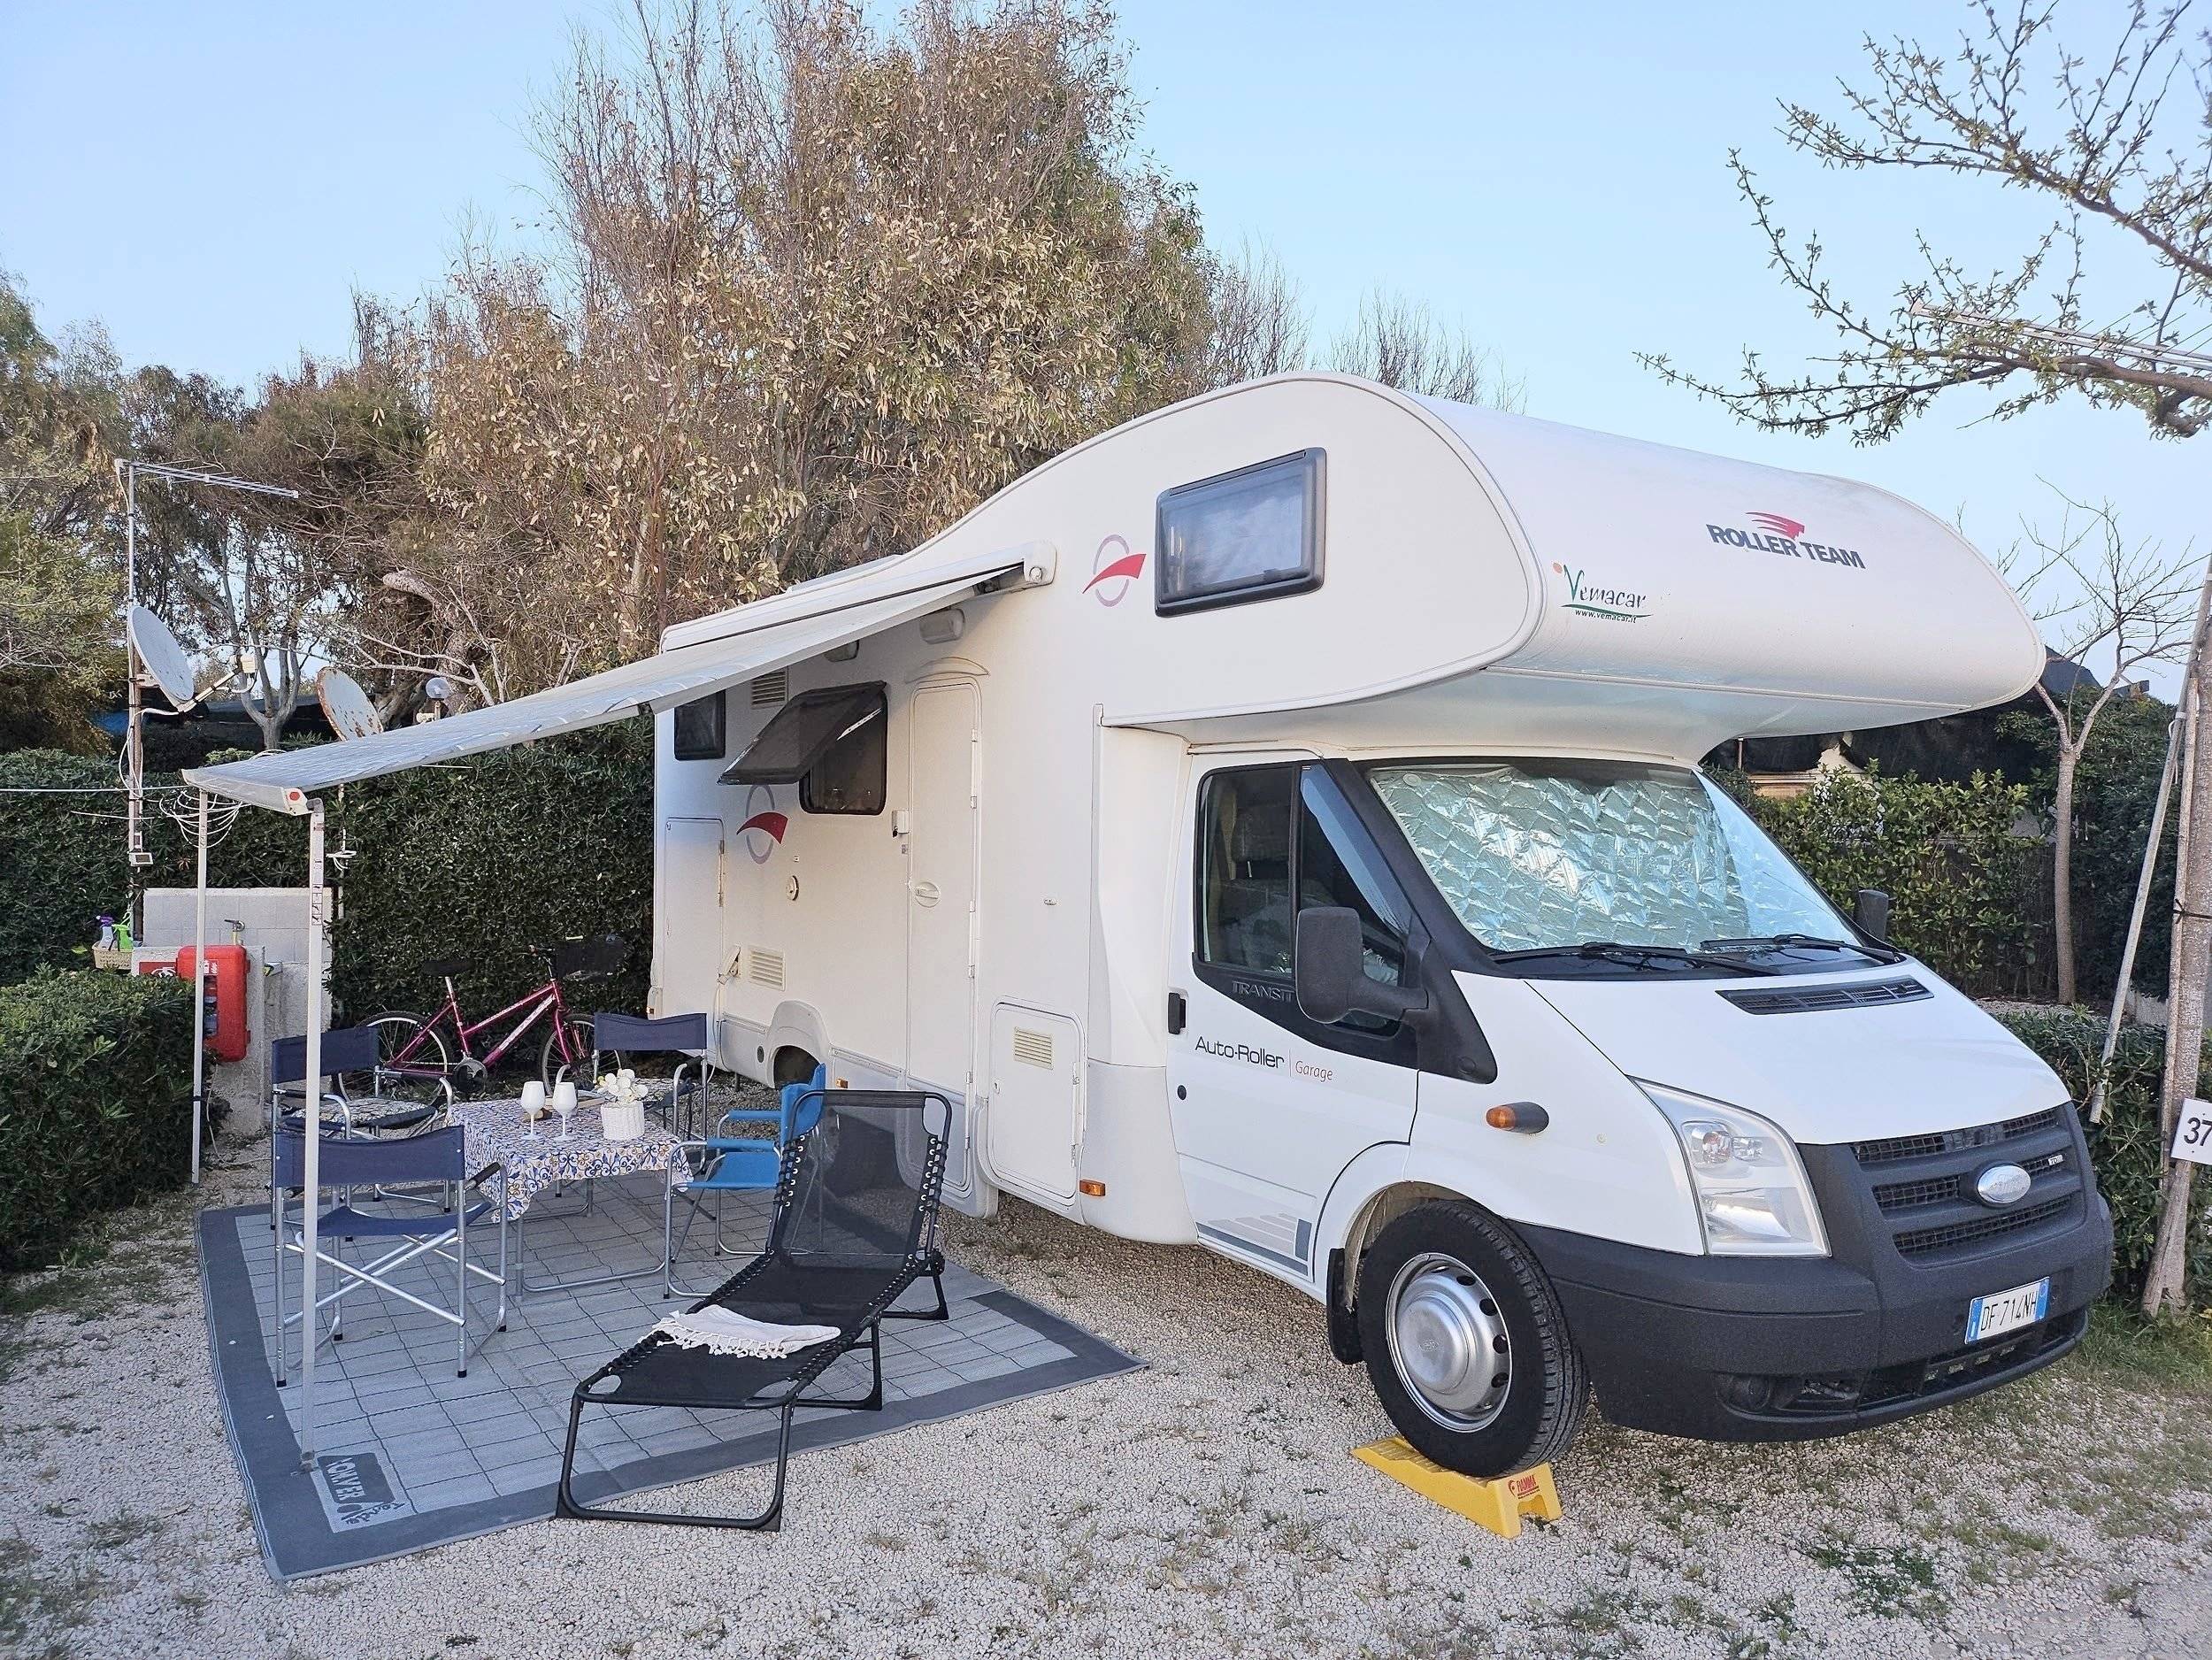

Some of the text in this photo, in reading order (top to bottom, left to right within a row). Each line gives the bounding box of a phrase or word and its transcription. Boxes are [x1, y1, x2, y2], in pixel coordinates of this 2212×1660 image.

[1706, 524, 1866, 569] ROLLER TEAM
[1563, 564, 1647, 608] Vemacar
[1575, 609, 1637, 624] www.vemacar.it
[1232, 980, 1295, 1003] TRANSIT
[1294, 1060, 1333, 1083] Garage
[2184, 1117, 2212, 1147] 37
[1981, 1303, 1998, 1331] DF
